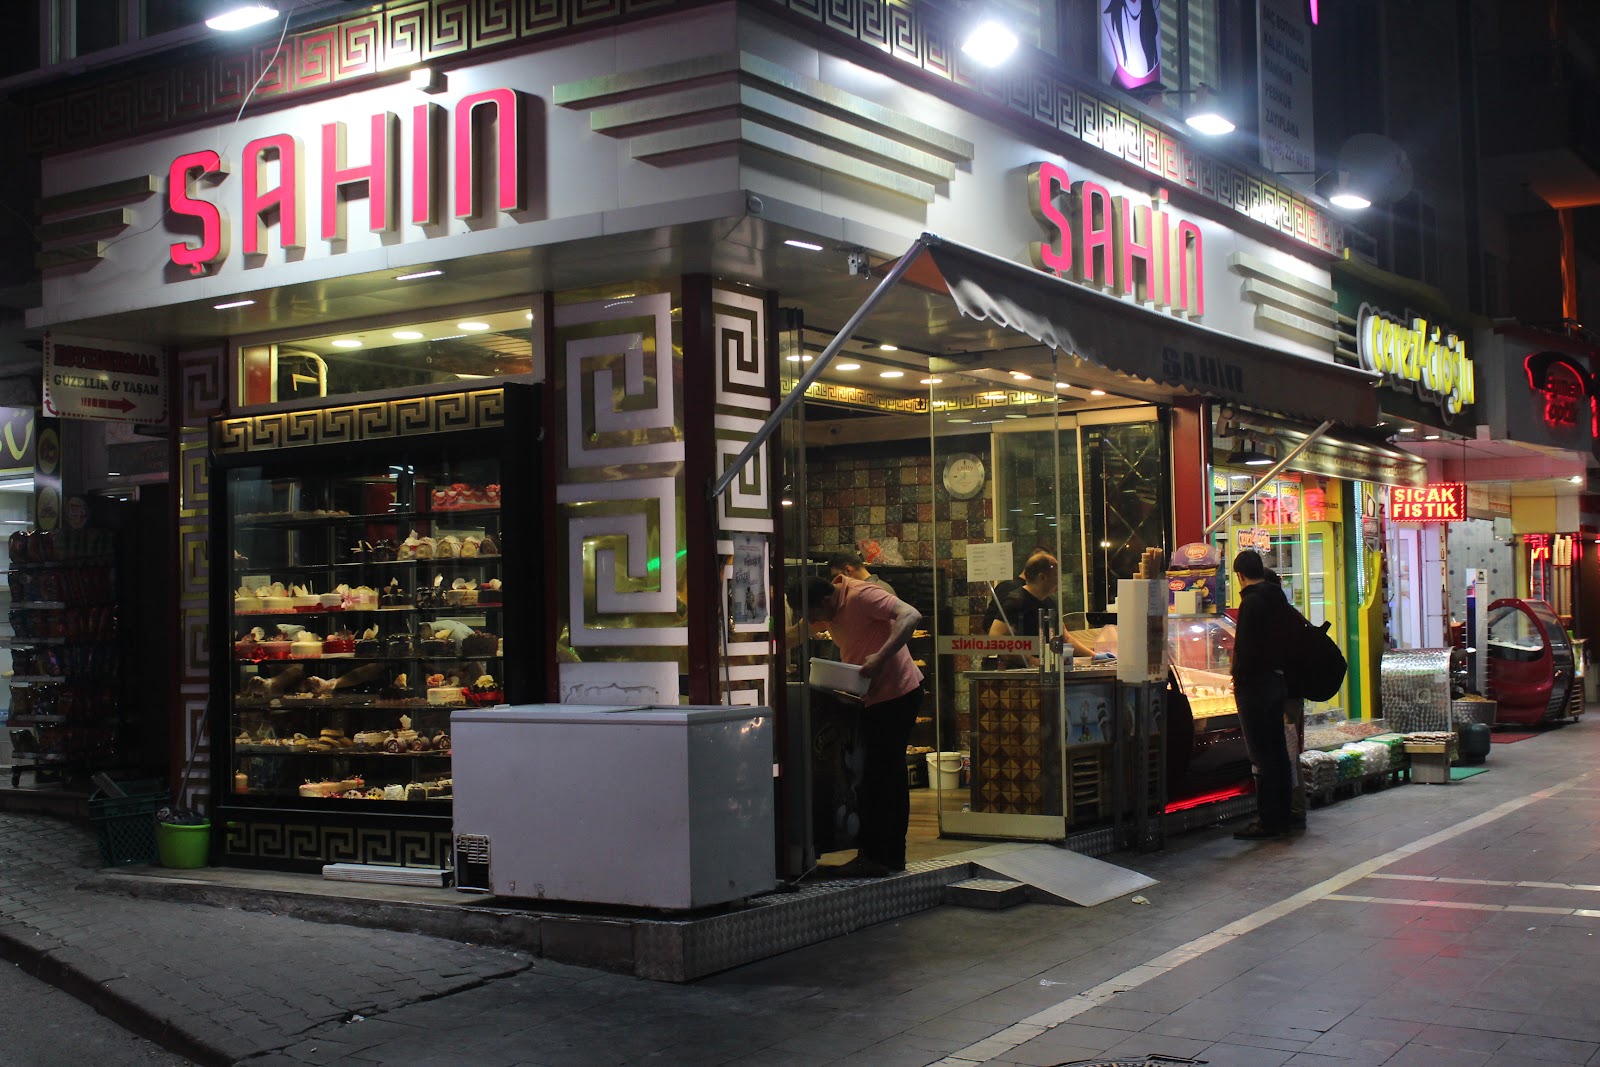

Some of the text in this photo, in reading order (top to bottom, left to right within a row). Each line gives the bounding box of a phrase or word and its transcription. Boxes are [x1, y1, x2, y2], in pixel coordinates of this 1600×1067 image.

[53, 372, 109, 391] GÜZELLİK
[122, 381, 160, 397] YAŞAM
[1394, 488, 1455, 503] SICAK
[1393, 502, 1458, 518] FISTIK
